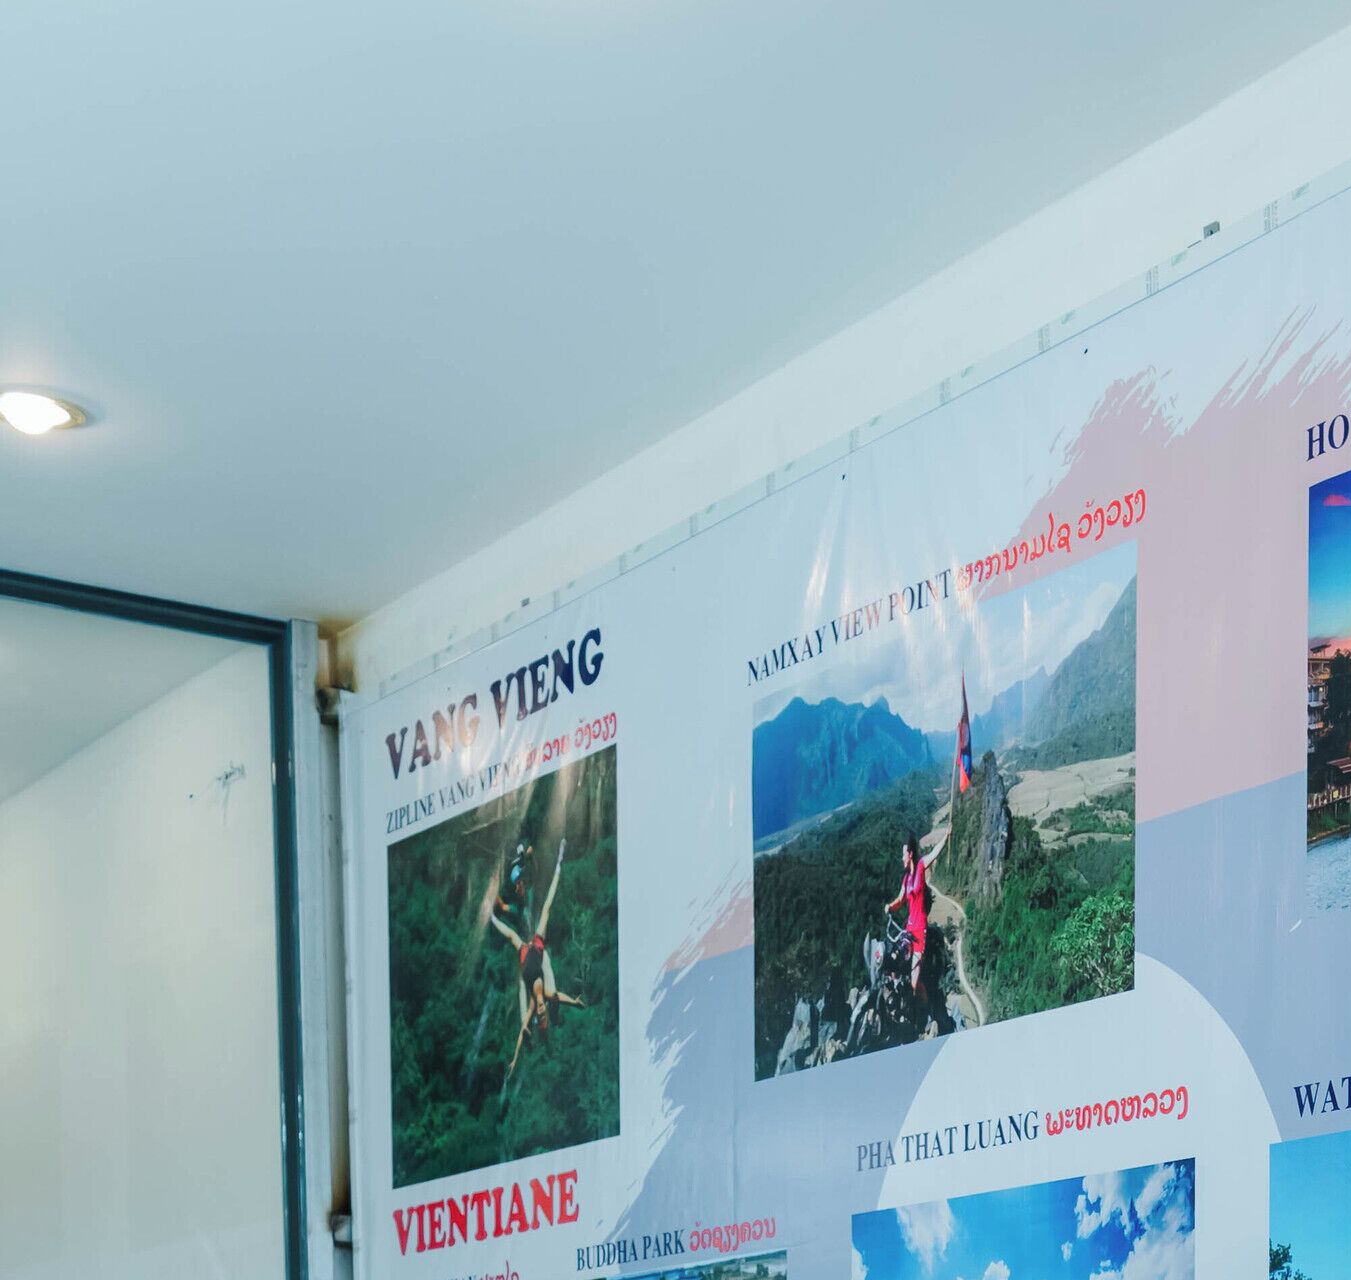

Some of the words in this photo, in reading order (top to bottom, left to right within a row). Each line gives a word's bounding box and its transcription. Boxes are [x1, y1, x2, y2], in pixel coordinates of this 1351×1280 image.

[747, 621, 827, 687] NAMXAY
[830, 597, 884, 646] VIEW
[888, 568, 952, 623] POINT
[385, 692, 480, 780] VANG
[490, 627, 604, 730] VIENG
[386, 792, 435, 834] ZIPLINE
[439, 775, 475, 810] VANG
[856, 1138, 897, 1173] PHA
[901, 1126, 958, 1162] THAT
[963, 1110, 1039, 1153] LUANG
[392, 1169, 580, 1256] VIENTIANE
[576, 1234, 638, 1272] BUDDHA
[642, 1229, 686, 1261] PARK
